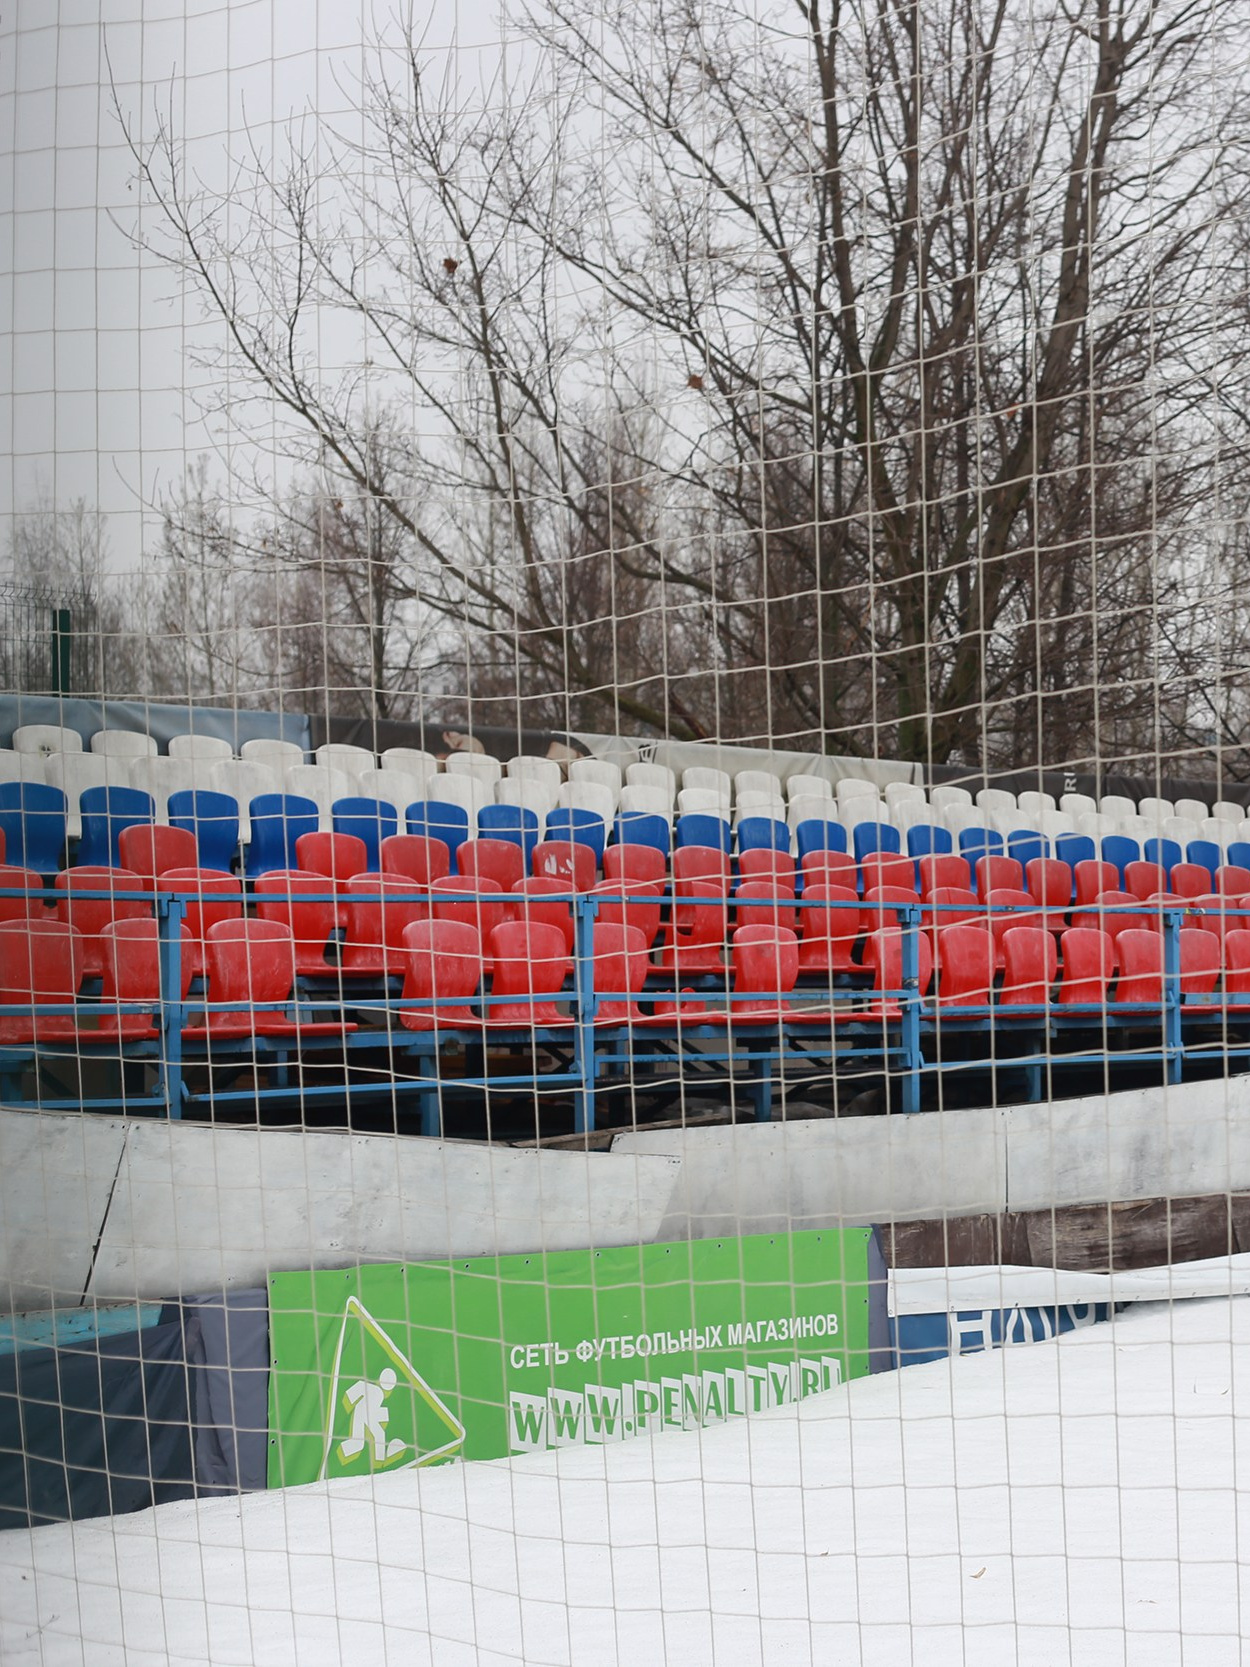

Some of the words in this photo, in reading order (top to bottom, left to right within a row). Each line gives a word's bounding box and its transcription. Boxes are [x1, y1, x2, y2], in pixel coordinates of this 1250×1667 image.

[510, 1342, 569, 1369] СЕТЬ
[575, 1325, 723, 1362] ФУТБОЛЬНЫХ
[728, 1313, 839, 1346] МАГАЗИНОВ
